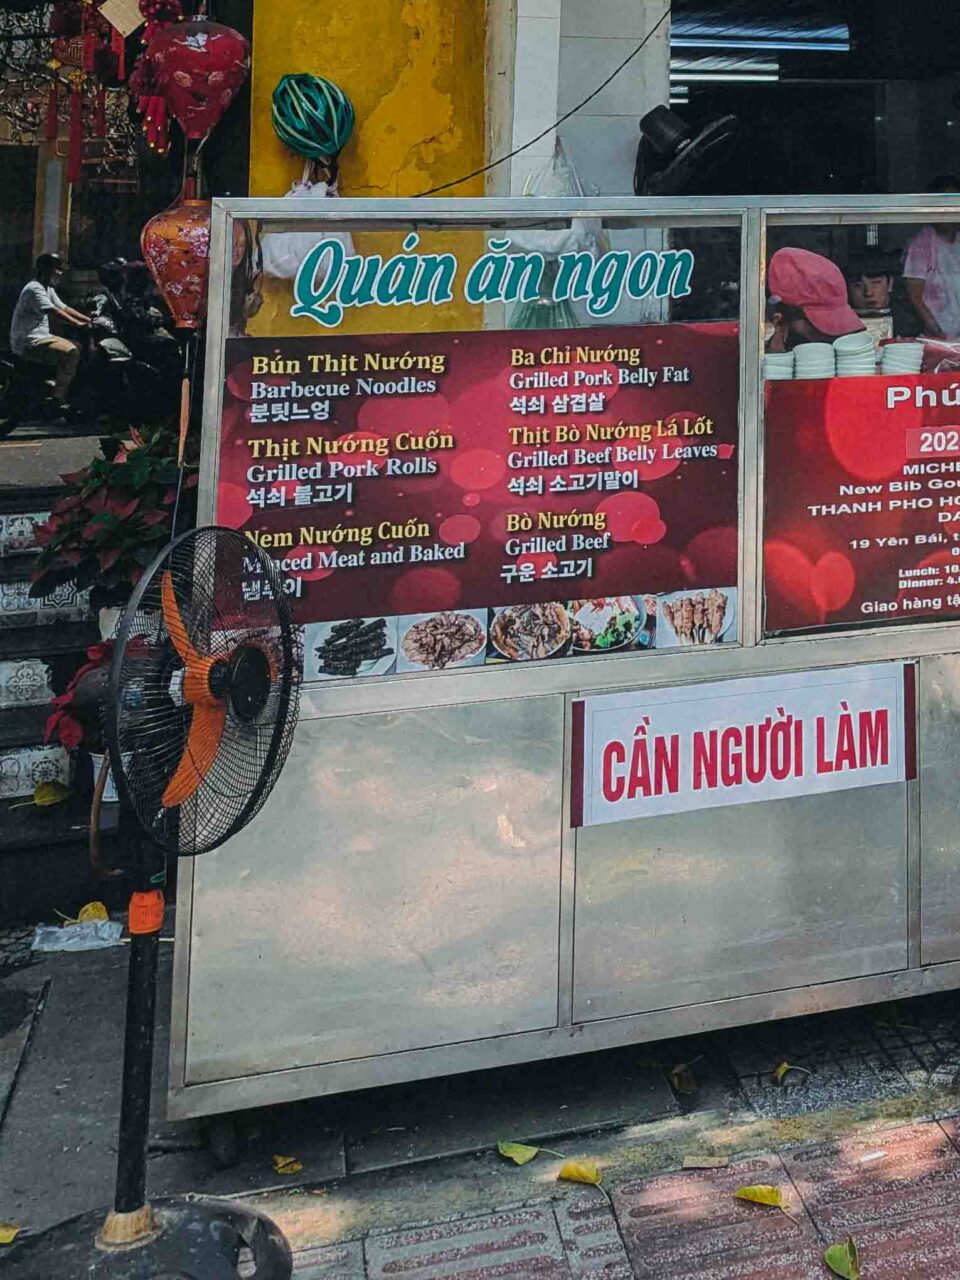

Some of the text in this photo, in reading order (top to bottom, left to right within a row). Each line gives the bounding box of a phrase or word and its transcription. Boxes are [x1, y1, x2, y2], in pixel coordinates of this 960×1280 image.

[289, 233, 696, 327] Quán ăn ngon
[252, 351, 445, 376] Bún Thịt Nướng
[511, 344, 640, 366] Ba Chỉ Nướng
[251, 378, 436, 399] Barbecue Noodles
[509, 366, 689, 389] Grilled Pork Belly Fat
[509, 391, 606, 415] 석쇠 삼겹살
[508, 416, 714, 448] Thịt Bò Nướng Lá Lốt
[248, 429, 454, 461] Thịt Nướng Cuốn
[507, 443, 718, 468] Grilled Beef Belly Leaves
[246, 457, 437, 483] Grilled Pork Rolls
[507, 469, 638, 495] 석쇠 소고기말이
[246, 483, 353, 508] 석쇠 불고기
[839, 485, 882, 496] New
[889, 481, 921, 493] Bib
[807, 501, 882, 516] THANH
[889, 498, 933, 510] PHO
[299, 524, 373, 545] Nướng
[378, 518, 430, 539] Cuốn
[506, 508, 606, 532] Bò Nướng
[505, 532, 611, 555] Grilled Beef
[850, 539, 870, 550] 19
[875, 536, 909, 548] Yên
[915, 532, 948, 545] Bái,
[242, 542, 465, 574] Mnced Meat and Baked
[500, 558, 593, 584] 구운 소고기
[899, 566, 940, 578] Lunch:
[899, 577, 943, 589] Dinner:
[861, 601, 898, 614] Giao
[903, 596, 942, 610] hàng
[602, 701, 889, 803] CẦN NGƯỜI LÀM
